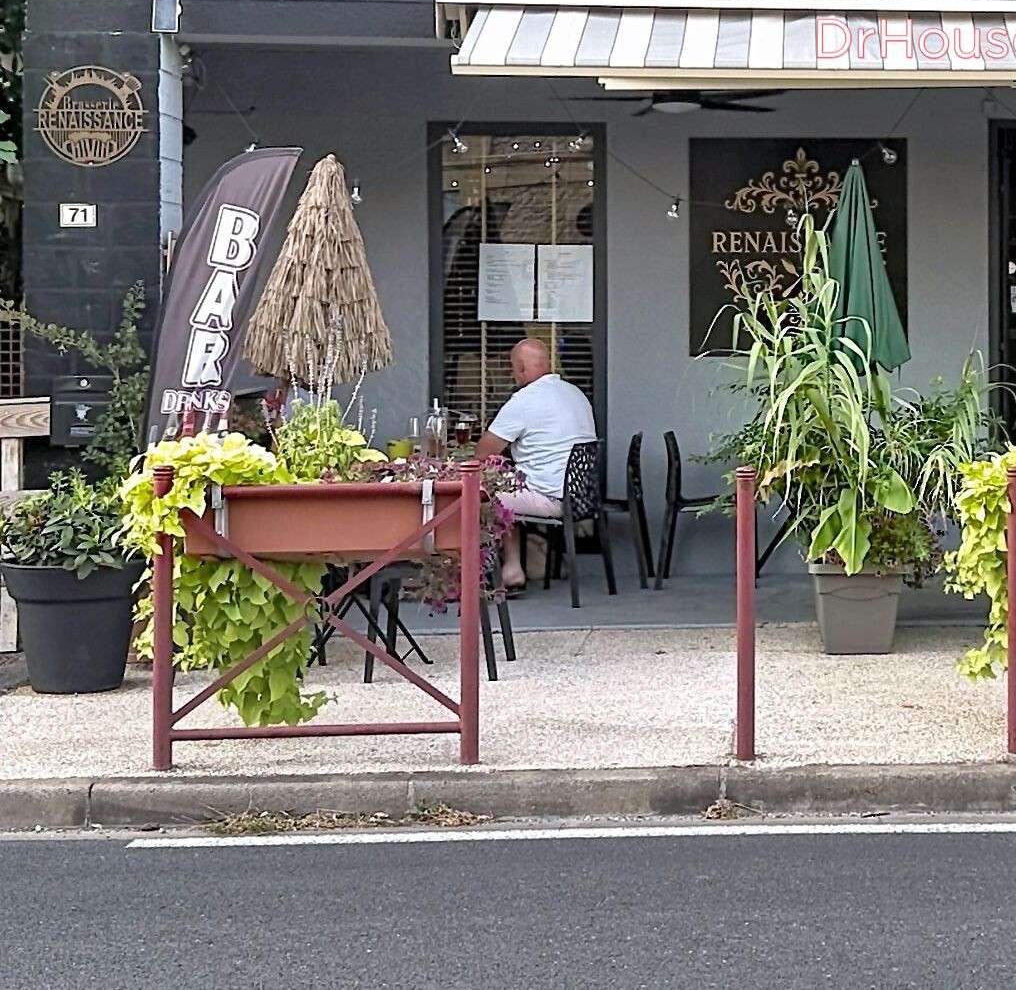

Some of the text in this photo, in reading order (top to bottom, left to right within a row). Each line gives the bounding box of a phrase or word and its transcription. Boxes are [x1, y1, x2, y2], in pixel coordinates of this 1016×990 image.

[63, 95, 119, 111] Brasserie
[38, 111, 143, 129] RENAISSANCE
[68, 207, 88, 223] 71
[711, 231, 888, 254] RENAISE
[182, 203, 261, 388] BAR
